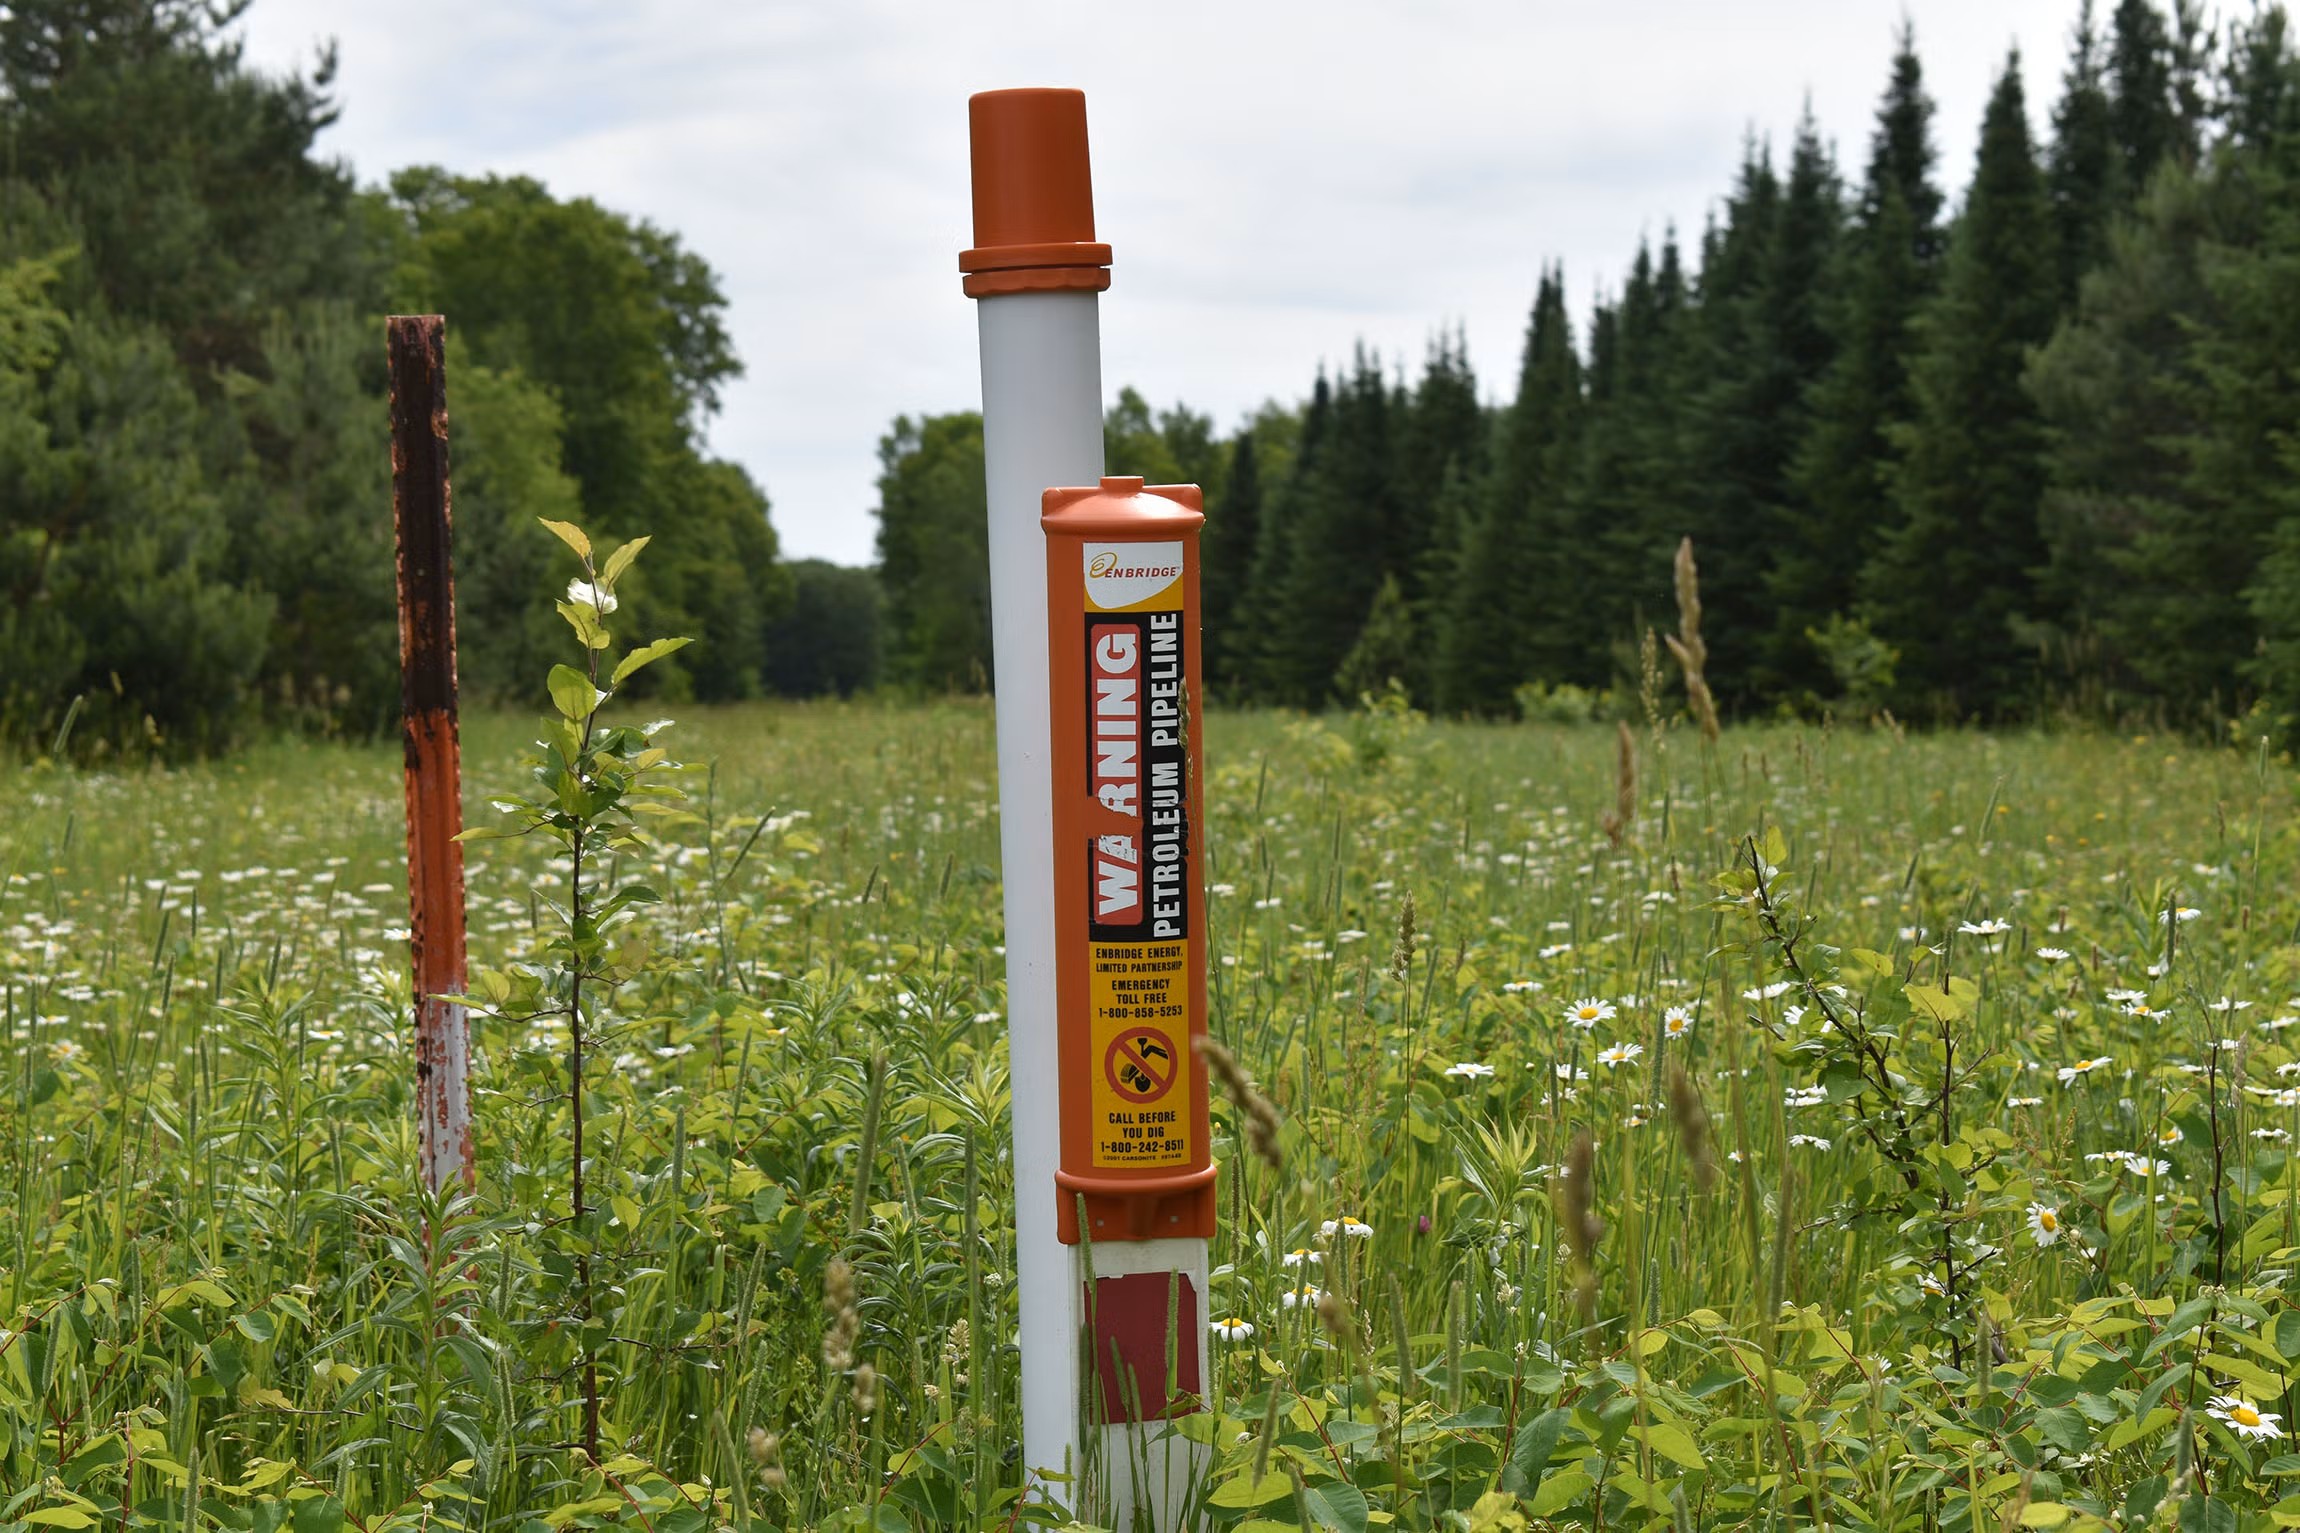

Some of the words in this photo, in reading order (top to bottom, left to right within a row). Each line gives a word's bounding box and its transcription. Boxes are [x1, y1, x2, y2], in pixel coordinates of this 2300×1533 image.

[1104, 567, 1176, 578] ENBRIDGE
[1151, 613, 1178, 747] PIPELINE
[1151, 761, 1180, 938] PETROLEUM
[1096, 948, 1143, 959] ENBRIDGE
[1096, 963, 1127, 973] LIMITED
[1131, 961, 1182, 972] PARTNERSHIP
[1112, 979, 1170, 990] EMERGENCY
[1116, 994, 1139, 1004] TOLL
[1144, 993, 1167, 1004] FREE
[1099, 1005, 1182, 1018] 1-800-858-5253
[1109, 1112, 1134, 1124] CALL
[1139, 1111, 1176, 1123] BEFORE
[1123, 1127, 1142, 1138] YOU
[1148, 1126, 1164, 1137] DIG
[1101, 1139, 1184, 1153] 1-800-242-8511
